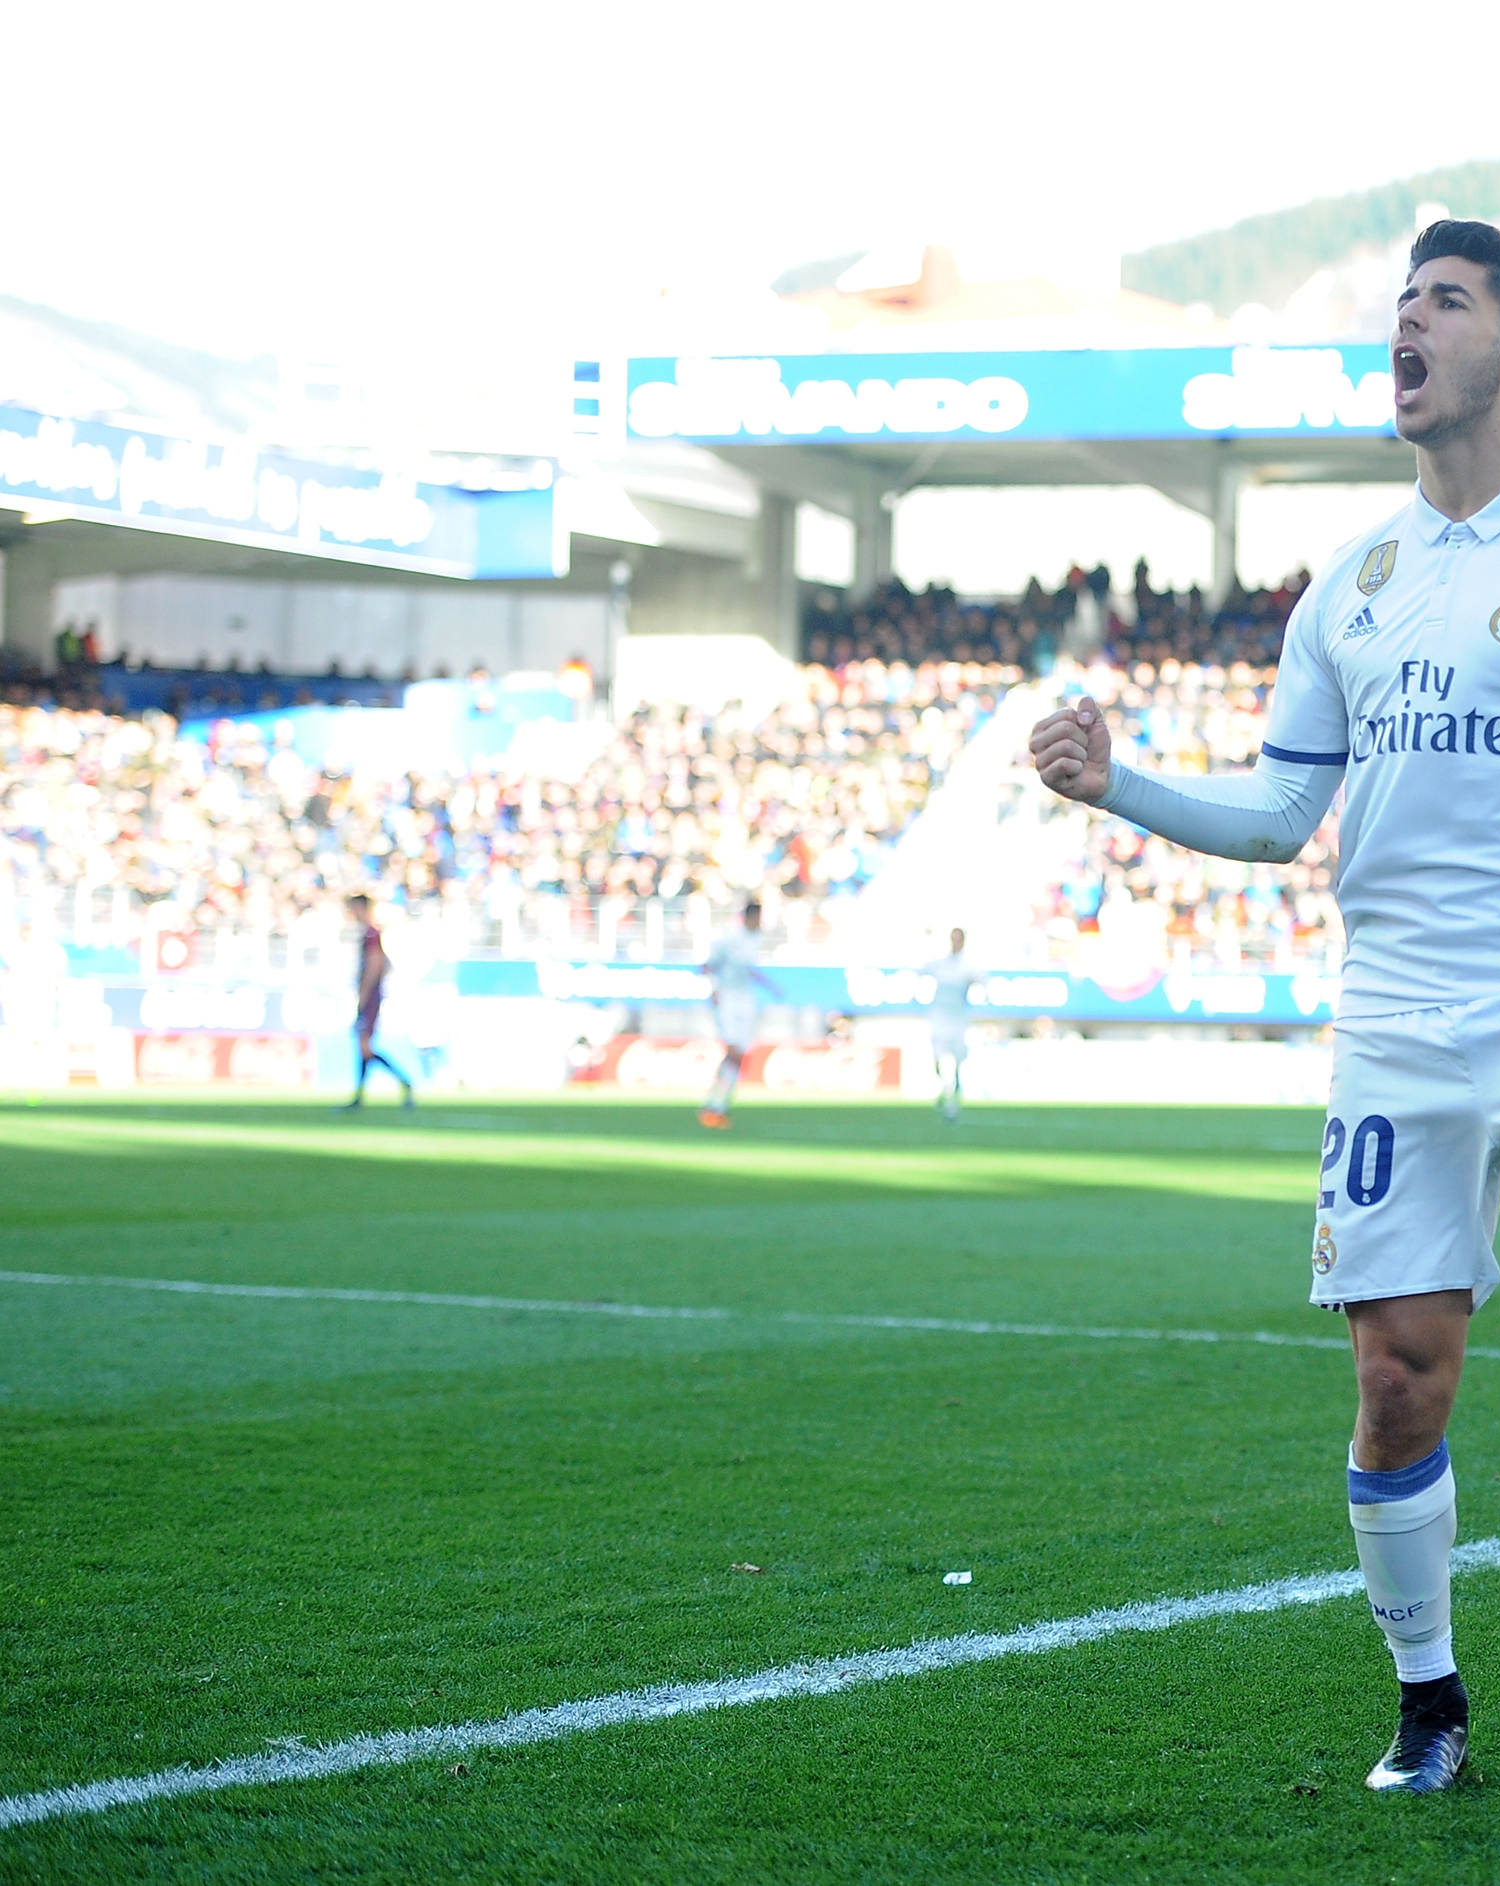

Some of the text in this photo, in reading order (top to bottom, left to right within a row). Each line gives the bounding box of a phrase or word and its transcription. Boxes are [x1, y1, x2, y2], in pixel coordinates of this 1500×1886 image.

[1342, 625, 1379, 641] adidas
[1401, 659, 1455, 701] Fly
[1318, 1114, 1395, 1210] 20
